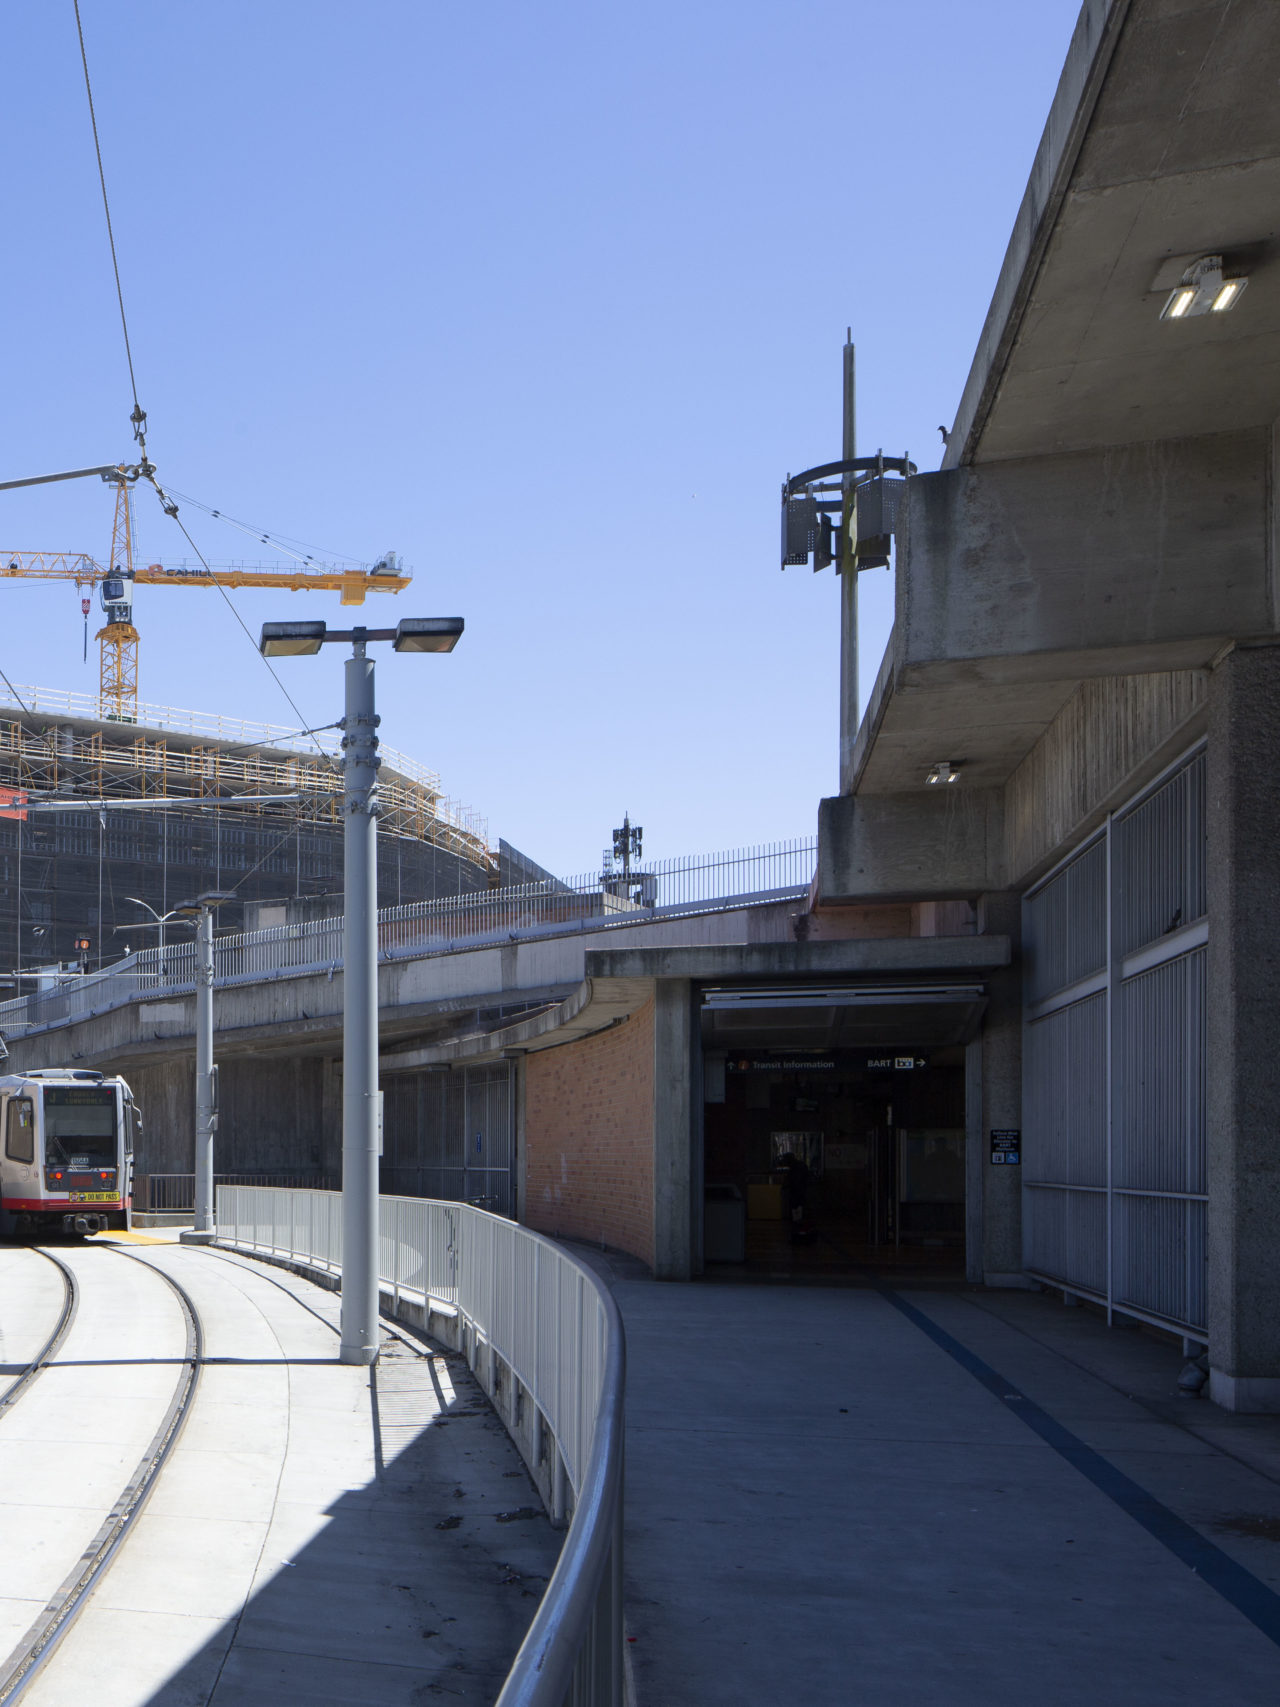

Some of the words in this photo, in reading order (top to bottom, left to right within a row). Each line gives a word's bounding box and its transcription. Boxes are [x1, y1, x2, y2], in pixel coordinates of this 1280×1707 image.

[753, 1060, 781, 1070] Transit
[783, 1060, 835, 1069] Information
[867, 1059, 891, 1068] BART
